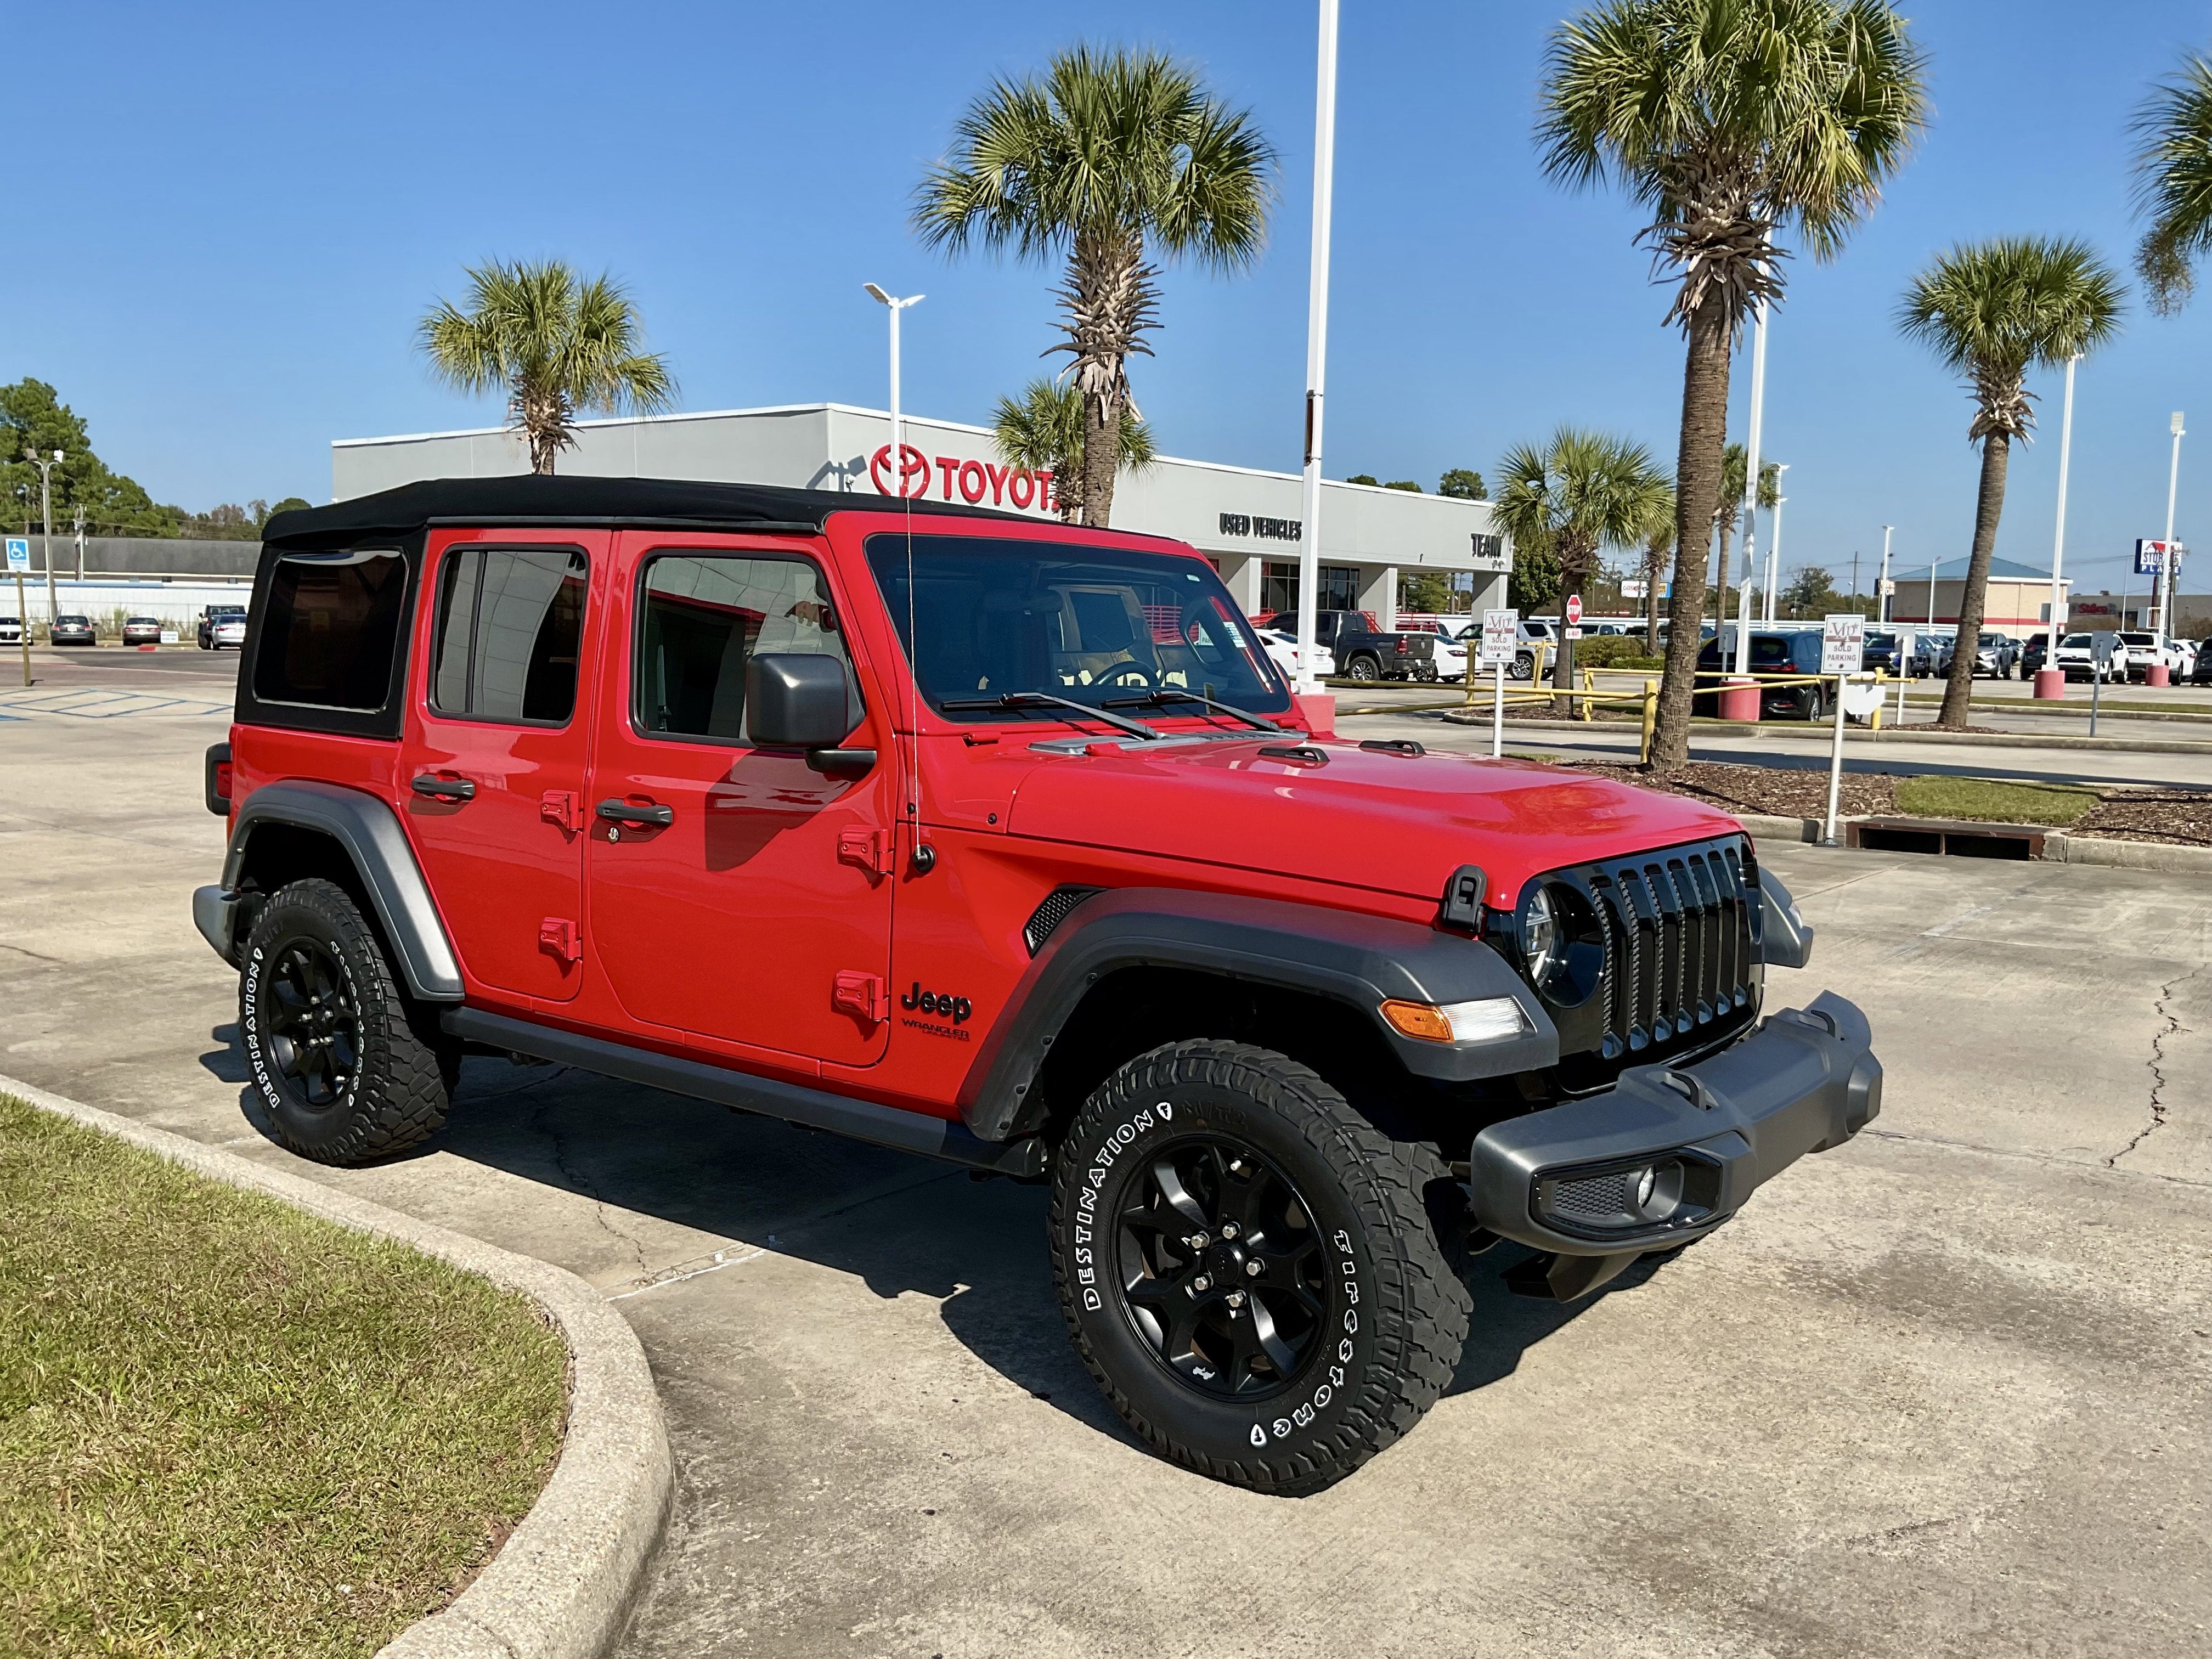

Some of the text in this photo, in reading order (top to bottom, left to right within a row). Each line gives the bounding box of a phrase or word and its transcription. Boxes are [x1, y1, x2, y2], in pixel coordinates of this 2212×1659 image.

[936, 456, 1060, 510] TOYOT
[1220, 513, 1302, 541] USED VEHICLES
[1471, 533, 1502, 558] TEAM
[1568, 605, 1580, 614] STOP
[901, 981, 972, 1025] Jeep
[246, 961, 280, 1108] DESTINATION
[901, 1018, 969, 1039] WRANGLER
[1076, 1109, 1154, 1311] DESTINATION
